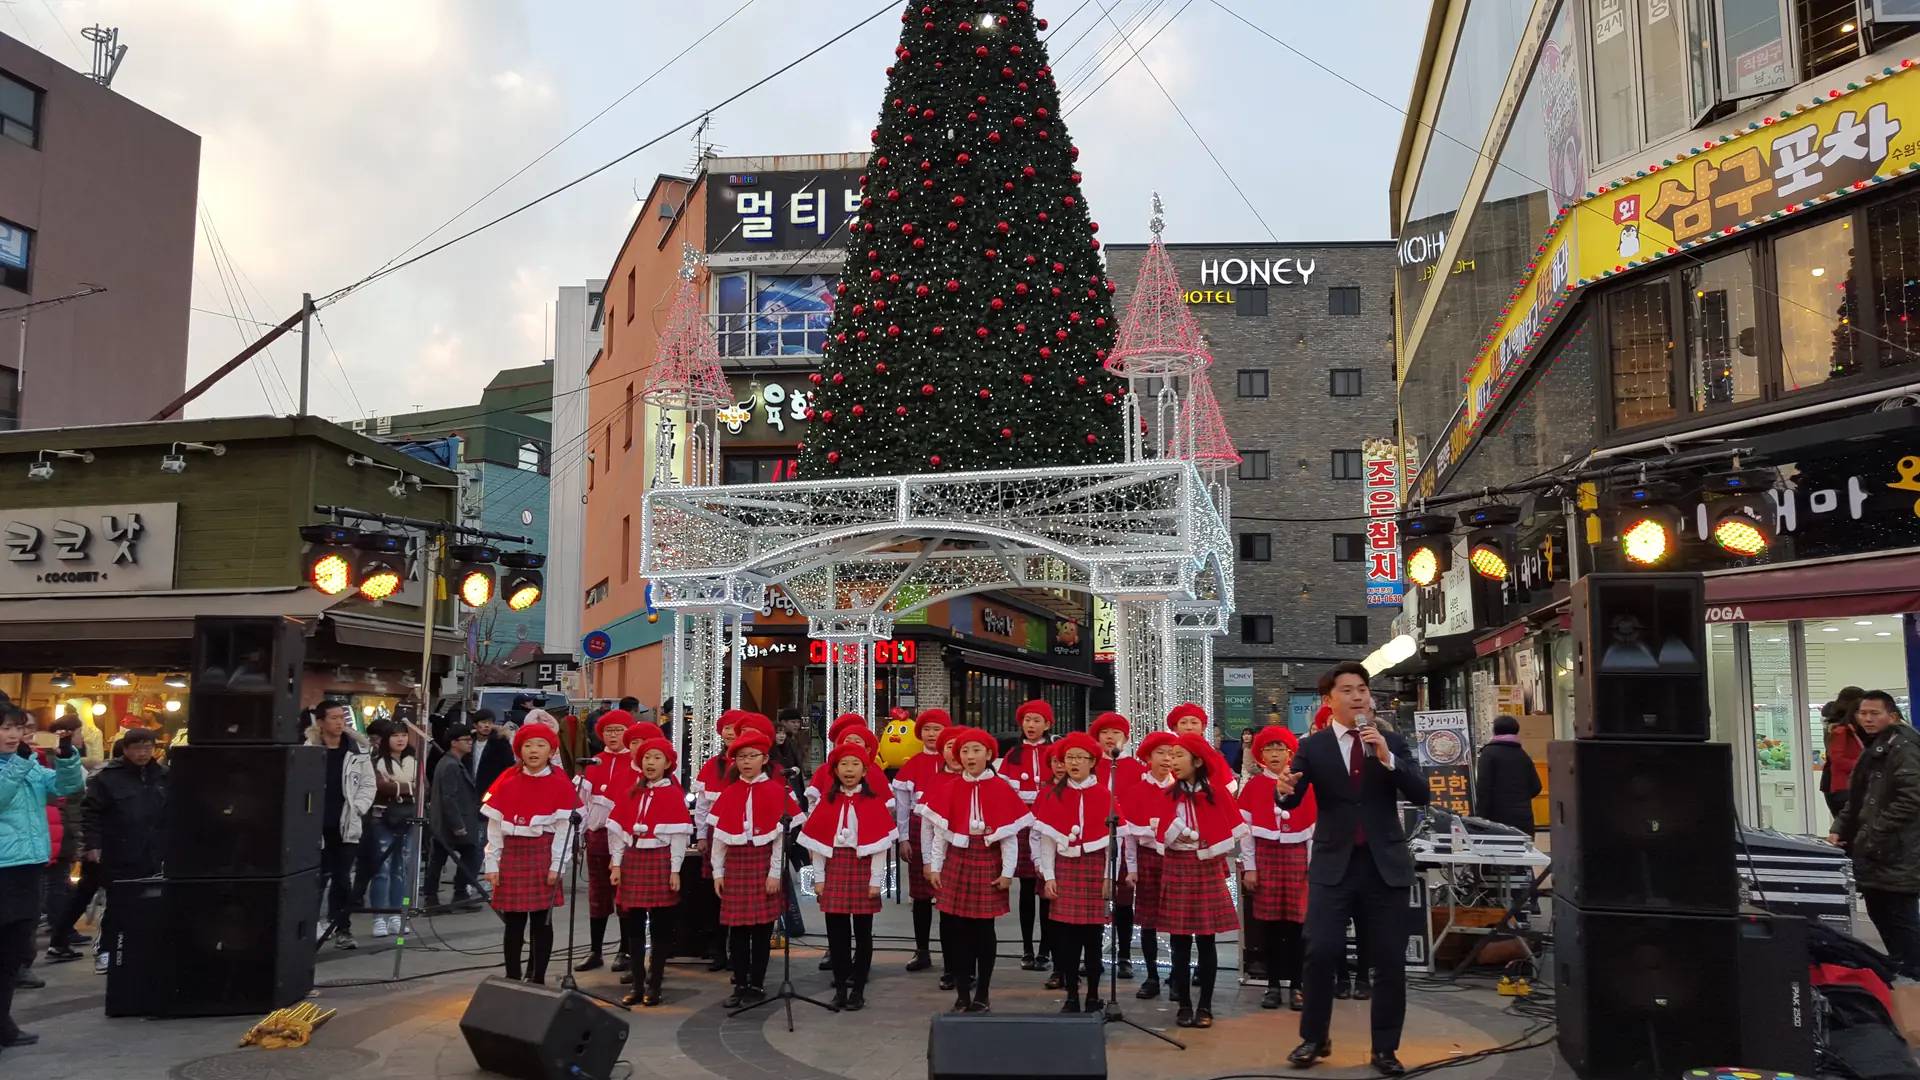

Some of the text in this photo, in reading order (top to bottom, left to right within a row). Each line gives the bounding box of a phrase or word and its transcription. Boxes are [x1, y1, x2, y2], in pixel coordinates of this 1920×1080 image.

[1597, 12, 1622, 38] 24시
[1645, 102, 1902, 243] 삼구포차
[1201, 258, 1315, 286] HONEY
[4, 512, 145, 565] 코코낫
[45, 571, 100, 583] COCONUT
[1225, 696, 1252, 704] HONEY
[1428, 775, 1467, 795] 무한
